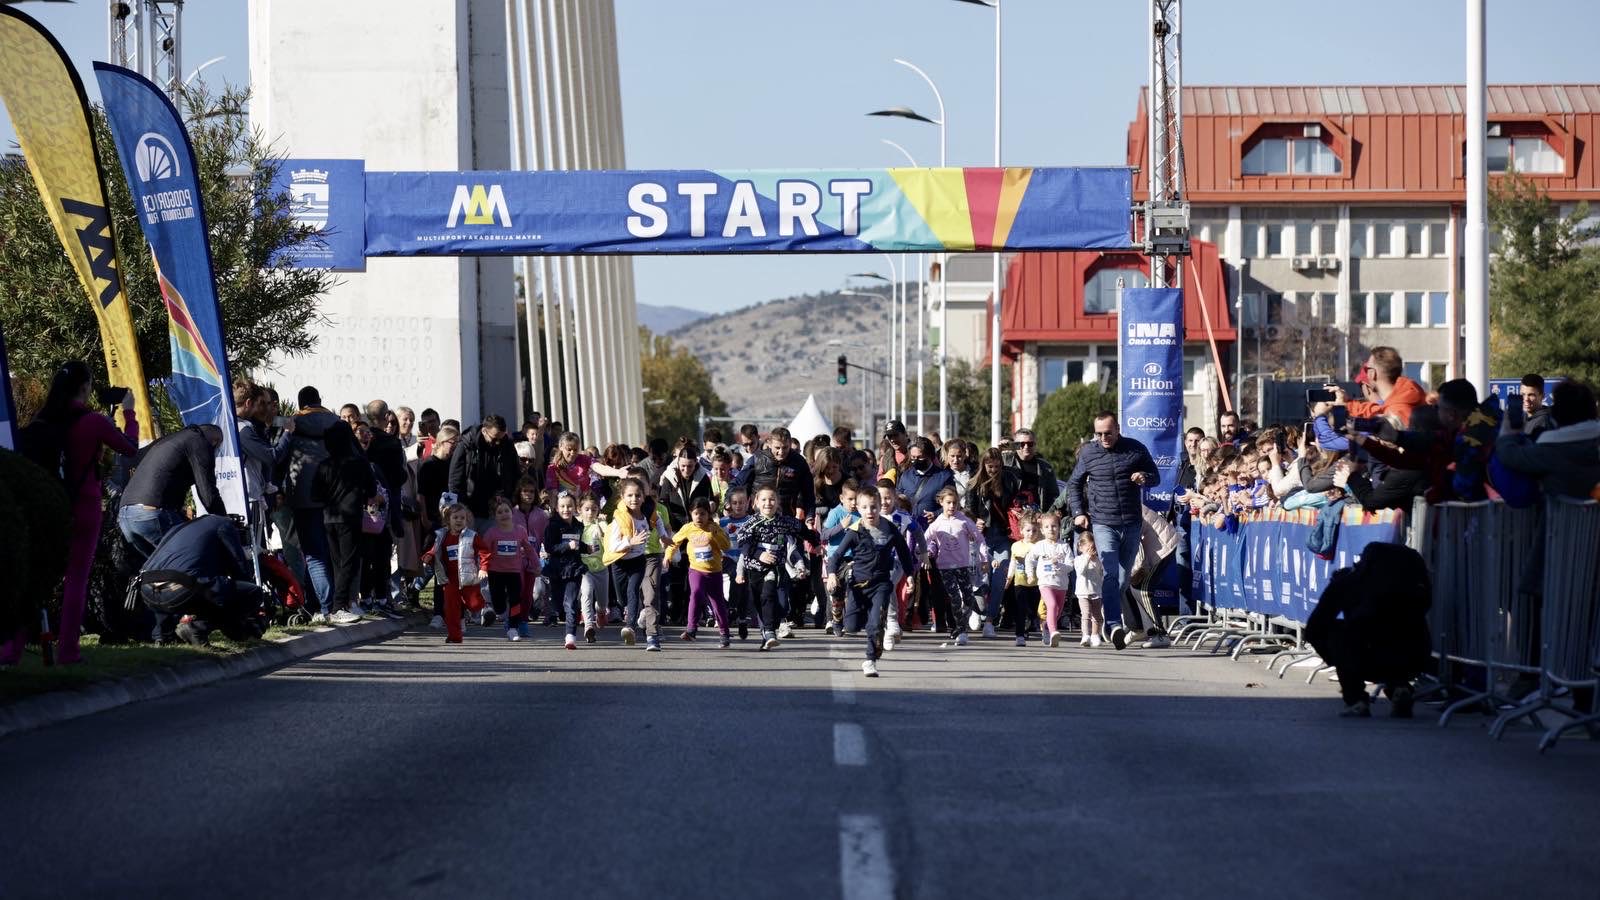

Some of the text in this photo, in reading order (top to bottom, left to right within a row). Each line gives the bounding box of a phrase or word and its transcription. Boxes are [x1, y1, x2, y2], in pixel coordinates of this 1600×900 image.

[627, 180, 872, 240] START
[1128, 337, 1177, 345] CRNA GORA
[1131, 378, 1173, 390] Hilton
[1127, 417, 1176, 428] GORSKA
